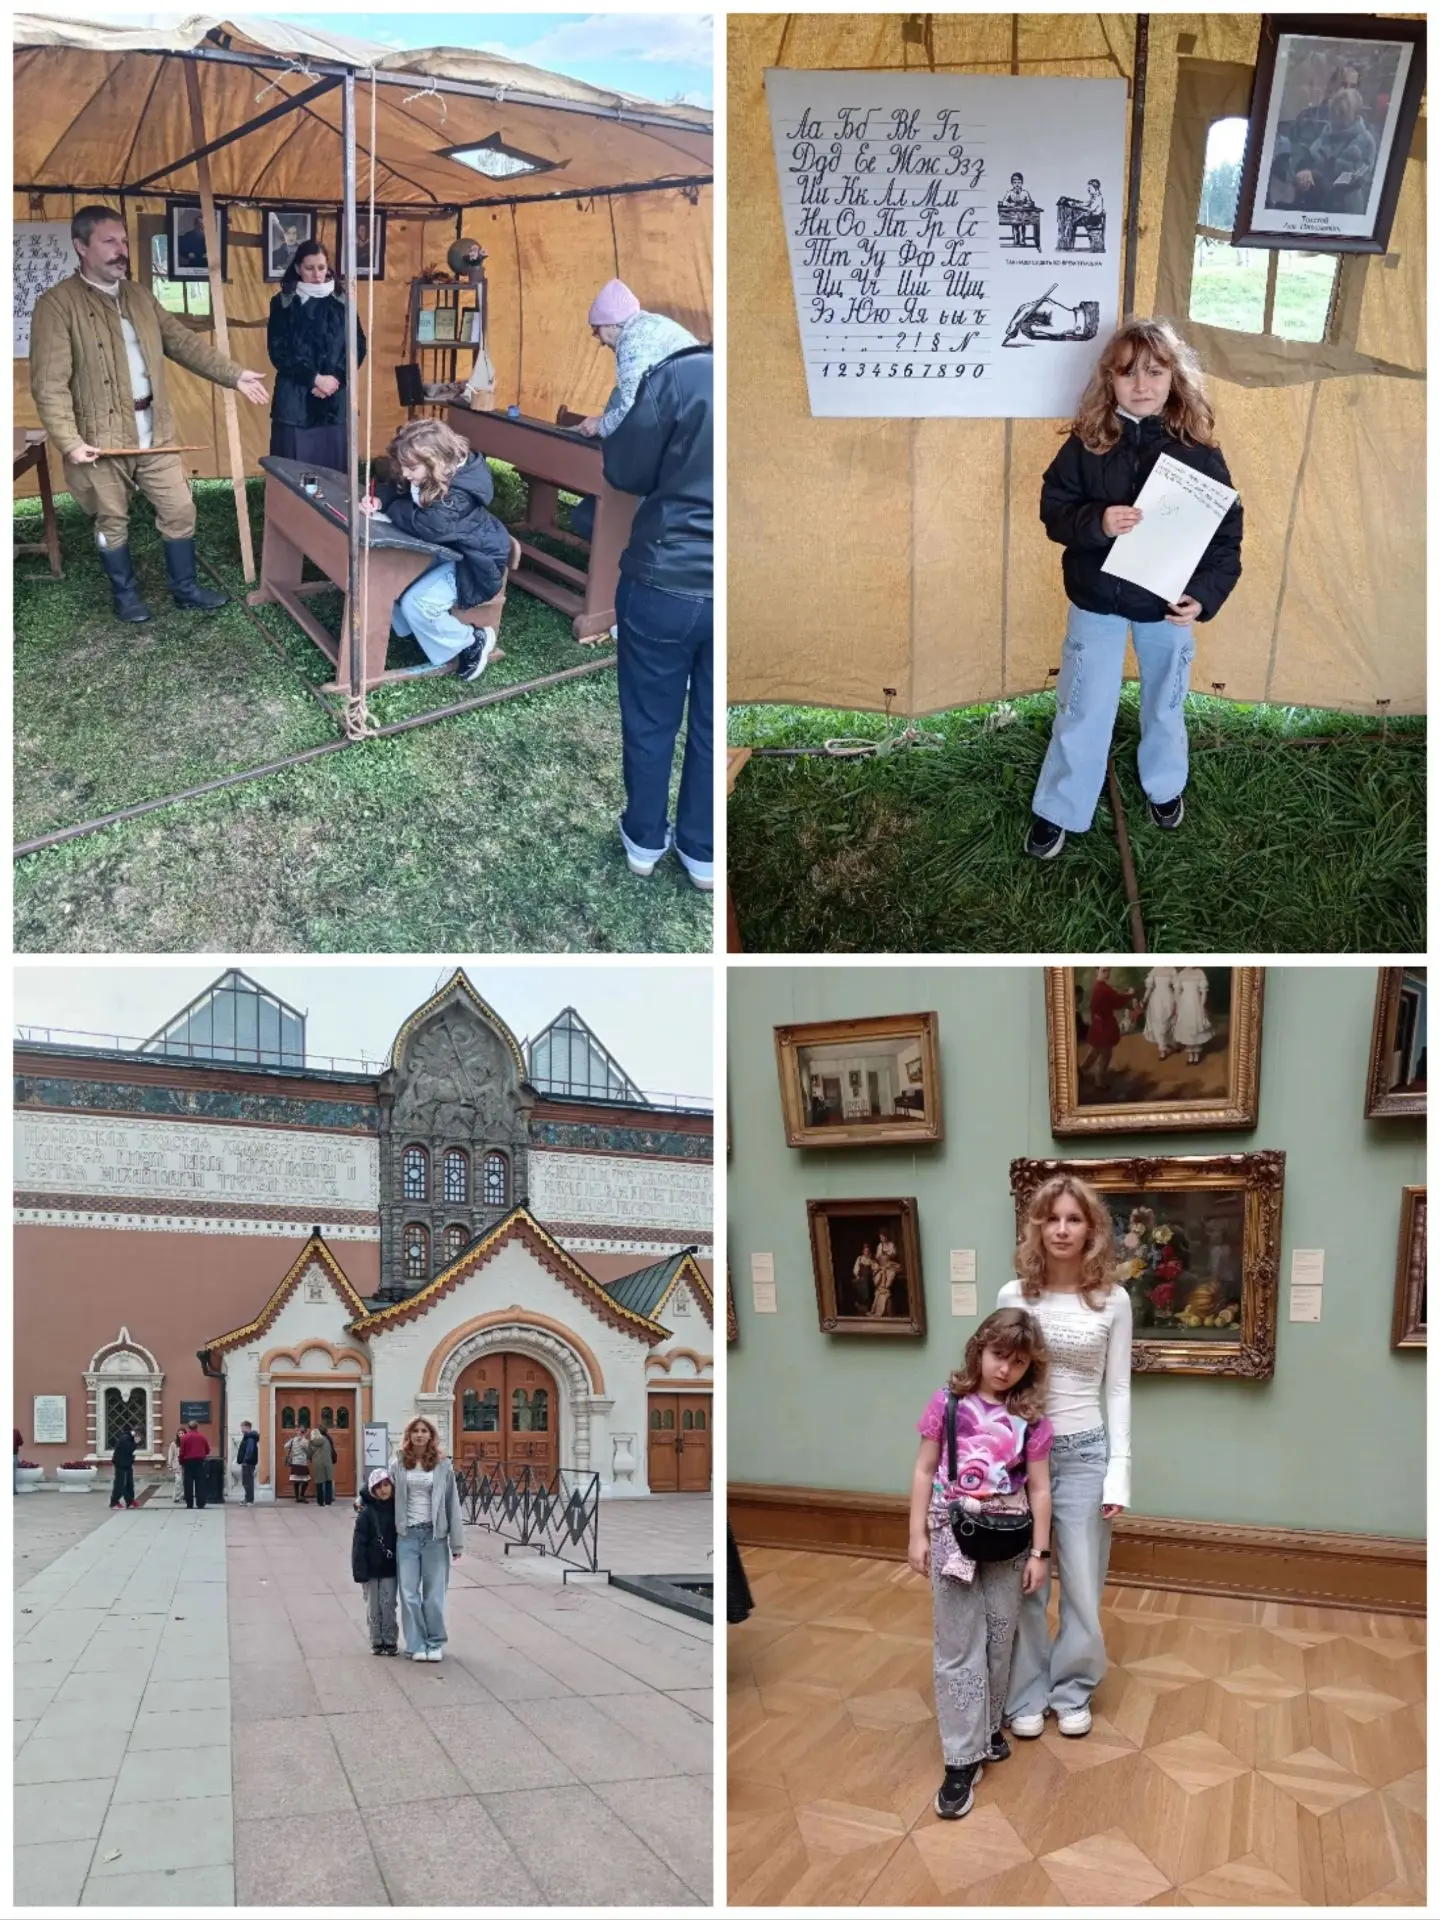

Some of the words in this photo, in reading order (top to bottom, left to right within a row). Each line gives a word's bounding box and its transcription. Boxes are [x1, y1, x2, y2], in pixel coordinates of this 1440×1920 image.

[786, 107, 823, 140] Аа
[834, 107, 882, 140] Бб
[887, 108, 921, 141] Вв
[933, 108, 962, 141] Гг
[855, 142, 876, 173] Ее
[887, 143, 941, 175] Жж
[797, 174, 830, 206] Ии
[834, 175, 870, 206] Кк
[873, 177, 908, 207] Лл
[912, 178, 959, 207] Мм
[794, 207, 831, 237] Нн
[836, 207, 866, 237] Оо
[873, 207, 908, 237] Пп
[916, 207, 945, 249] Рр
[956, 207, 979, 238] Сс
[803, 237, 851, 267] Тт
[857, 238, 886, 277] Уу
[898, 239, 935, 277] Фф
[941, 239, 972, 267] Хх
[812, 268, 843, 298] Цц
[850, 268, 880, 296] Чч
[897, 269, 932, 297] Шш
[943, 269, 985, 299] Щщ
[810, 297, 835, 324] Ээ
[841, 296, 890, 324] Юю
[899, 297, 929, 324] Яя
